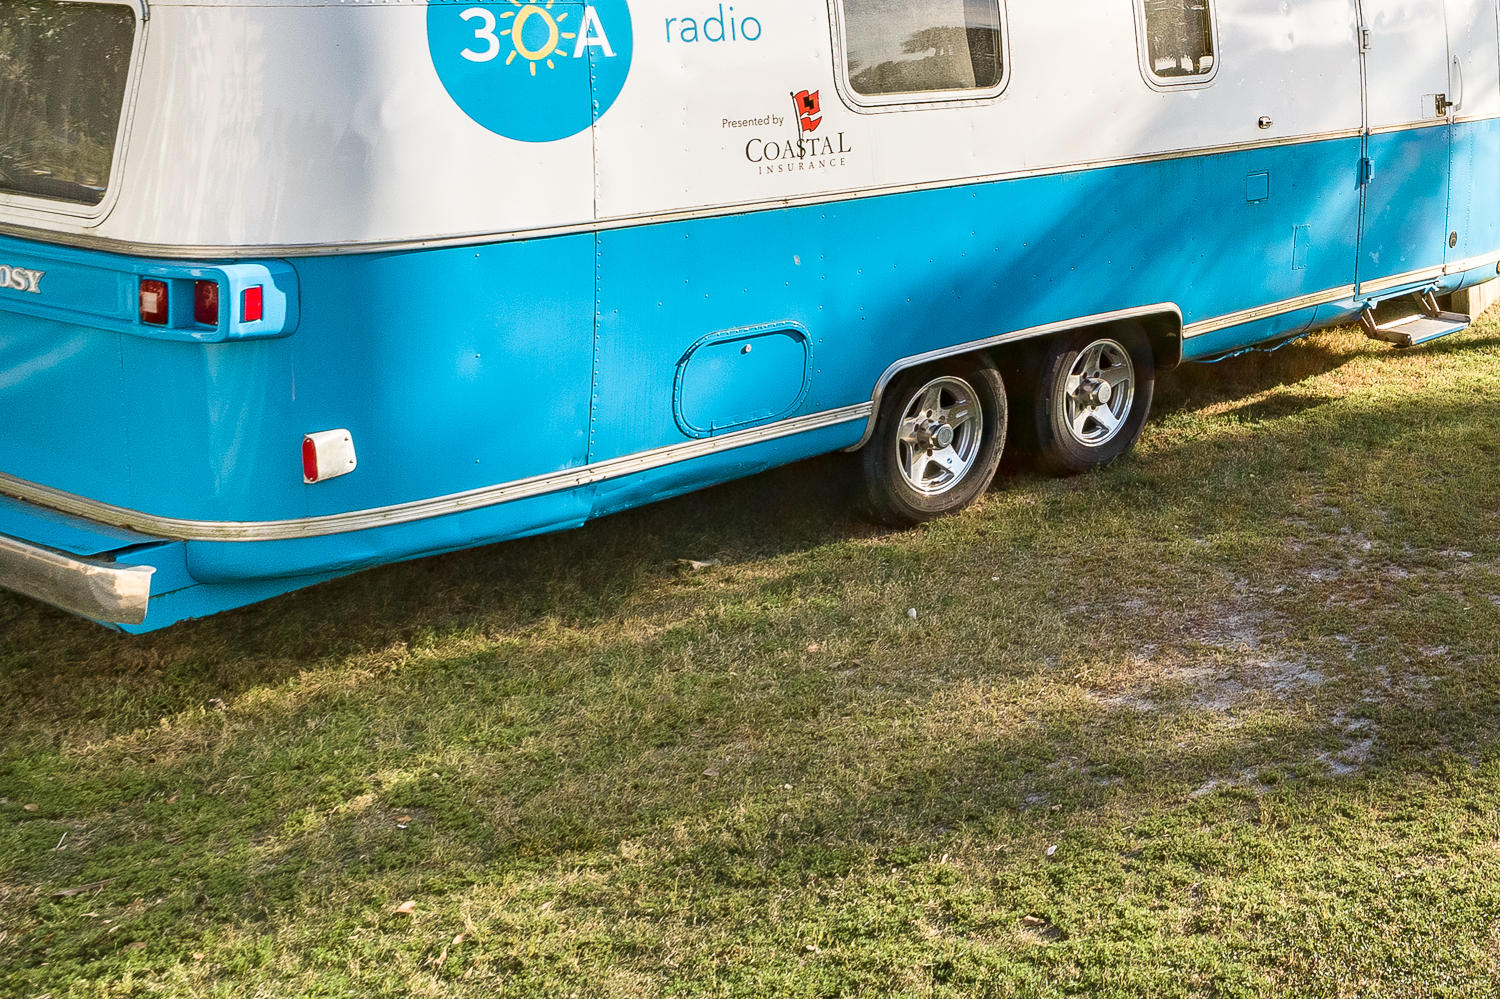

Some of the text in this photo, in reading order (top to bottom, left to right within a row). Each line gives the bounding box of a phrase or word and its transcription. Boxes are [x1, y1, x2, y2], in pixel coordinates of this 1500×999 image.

[665, 3, 761, 42] radio
[721, 113, 785, 129] Presented by
[758, 157, 847, 175] INSURANCE
